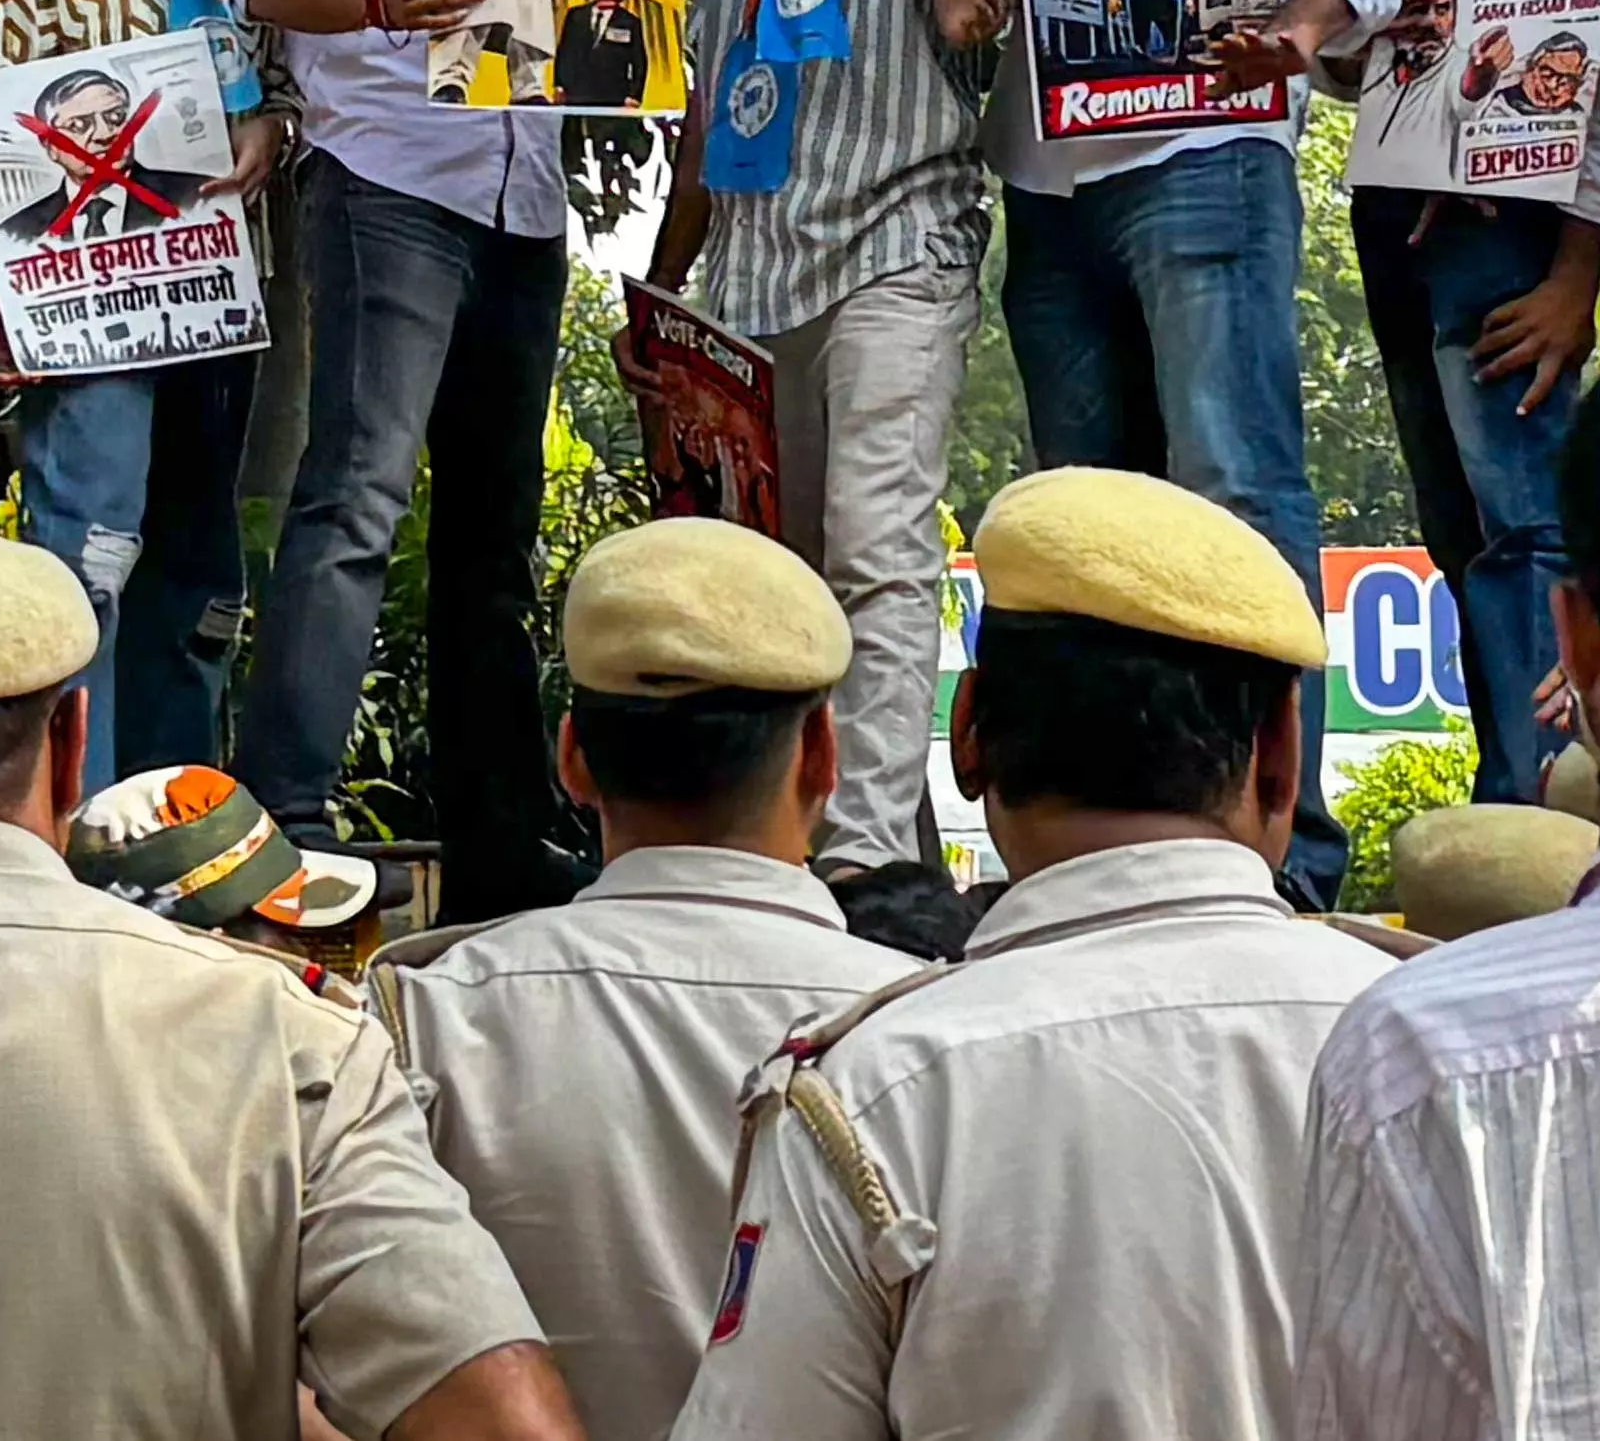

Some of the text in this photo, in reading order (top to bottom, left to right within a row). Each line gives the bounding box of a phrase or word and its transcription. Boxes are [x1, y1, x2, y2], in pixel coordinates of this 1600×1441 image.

[1060, 74, 1194, 134] Removal
[1471, 142, 1575, 177] EXPOSED
[86, 233, 160, 287] कुमार
[161, 208, 241, 266] हटाओ
[24, 265, 237, 336] चुनाव आयोग बचाओ
